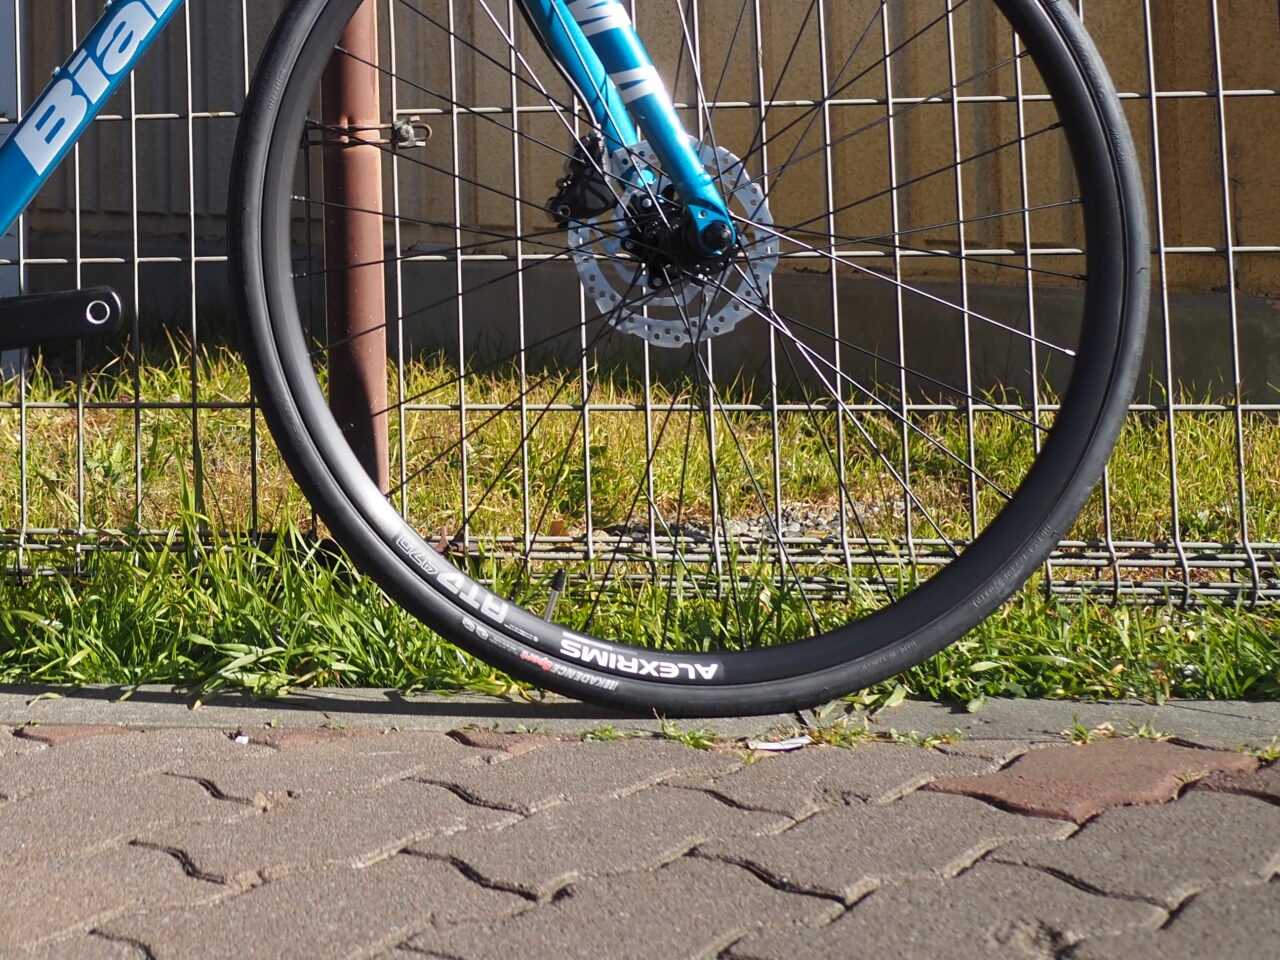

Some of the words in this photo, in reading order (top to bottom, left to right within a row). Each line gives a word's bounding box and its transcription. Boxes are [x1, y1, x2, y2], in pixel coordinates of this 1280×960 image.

[396, 534, 439, 576] 470
[436, 573, 509, 624] ATD
[550, 662, 607, 688] KADENCE
[560, 639, 719, 681] ALEXRIMS
